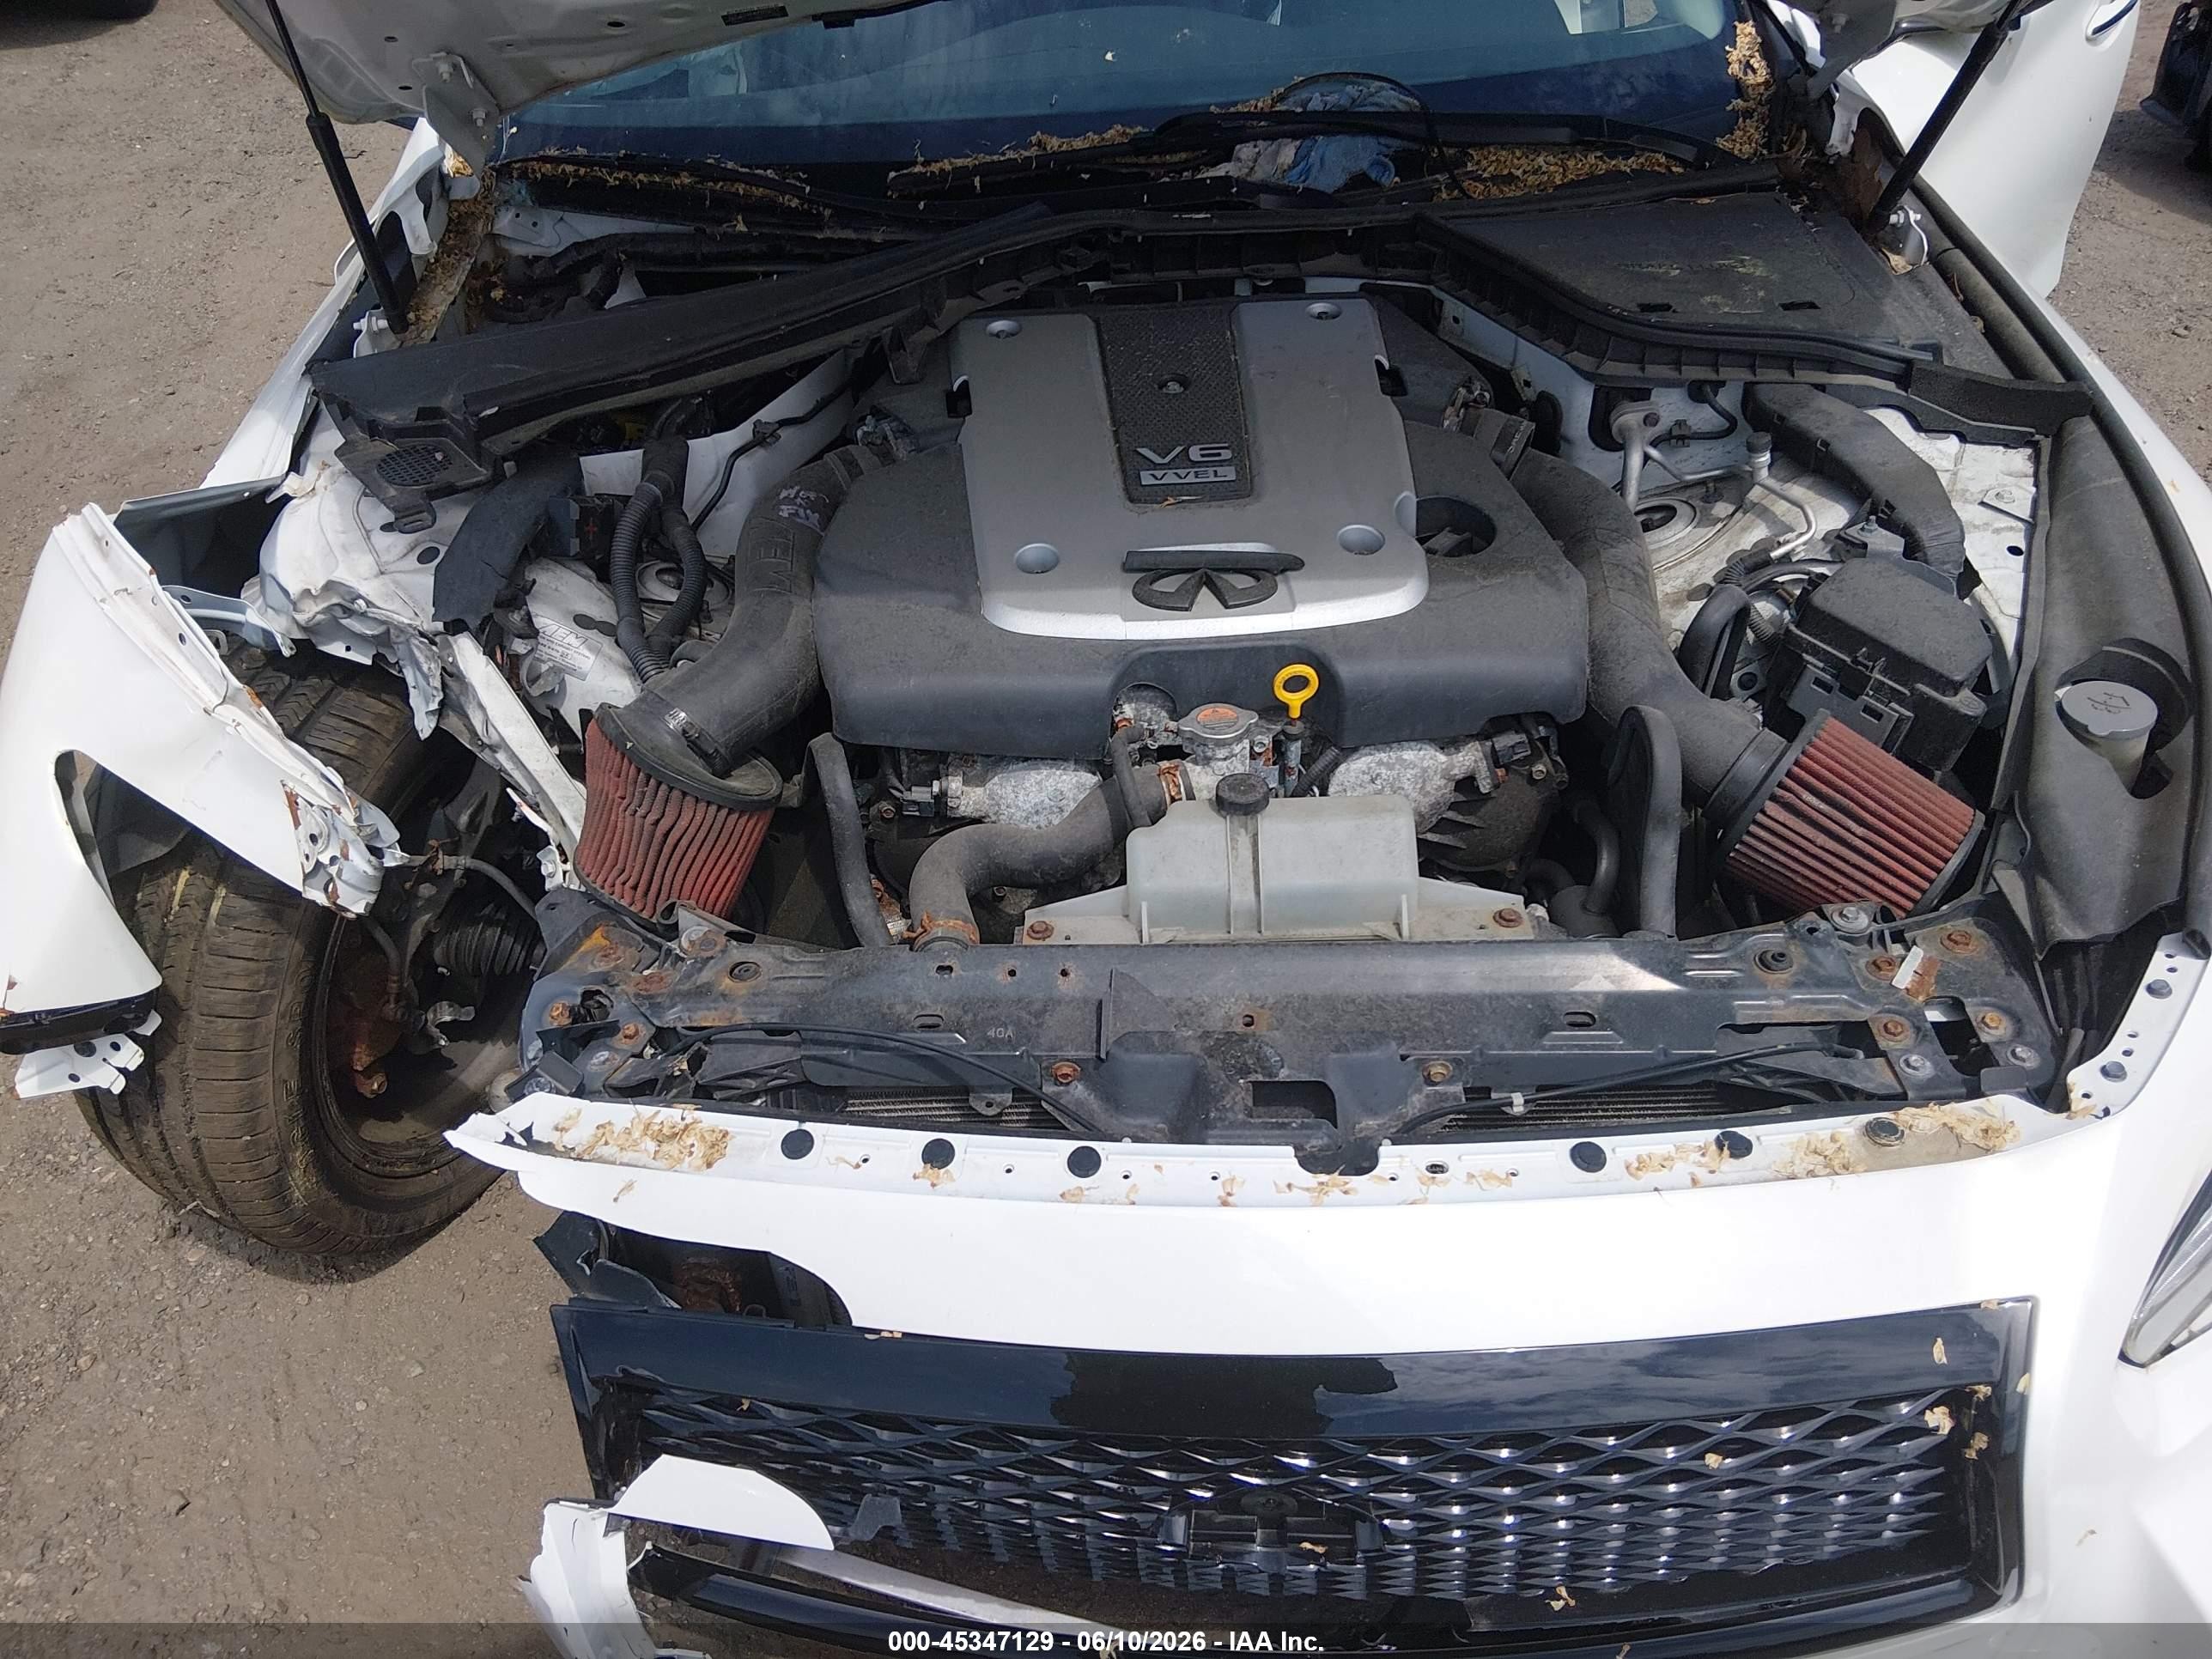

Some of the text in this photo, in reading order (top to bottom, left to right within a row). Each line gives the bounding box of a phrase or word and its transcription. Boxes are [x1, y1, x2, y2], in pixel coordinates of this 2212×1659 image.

[1135, 442, 1233, 465] V6
[1149, 469, 1229, 482] VVEL
[538, 623, 589, 649] AEM
